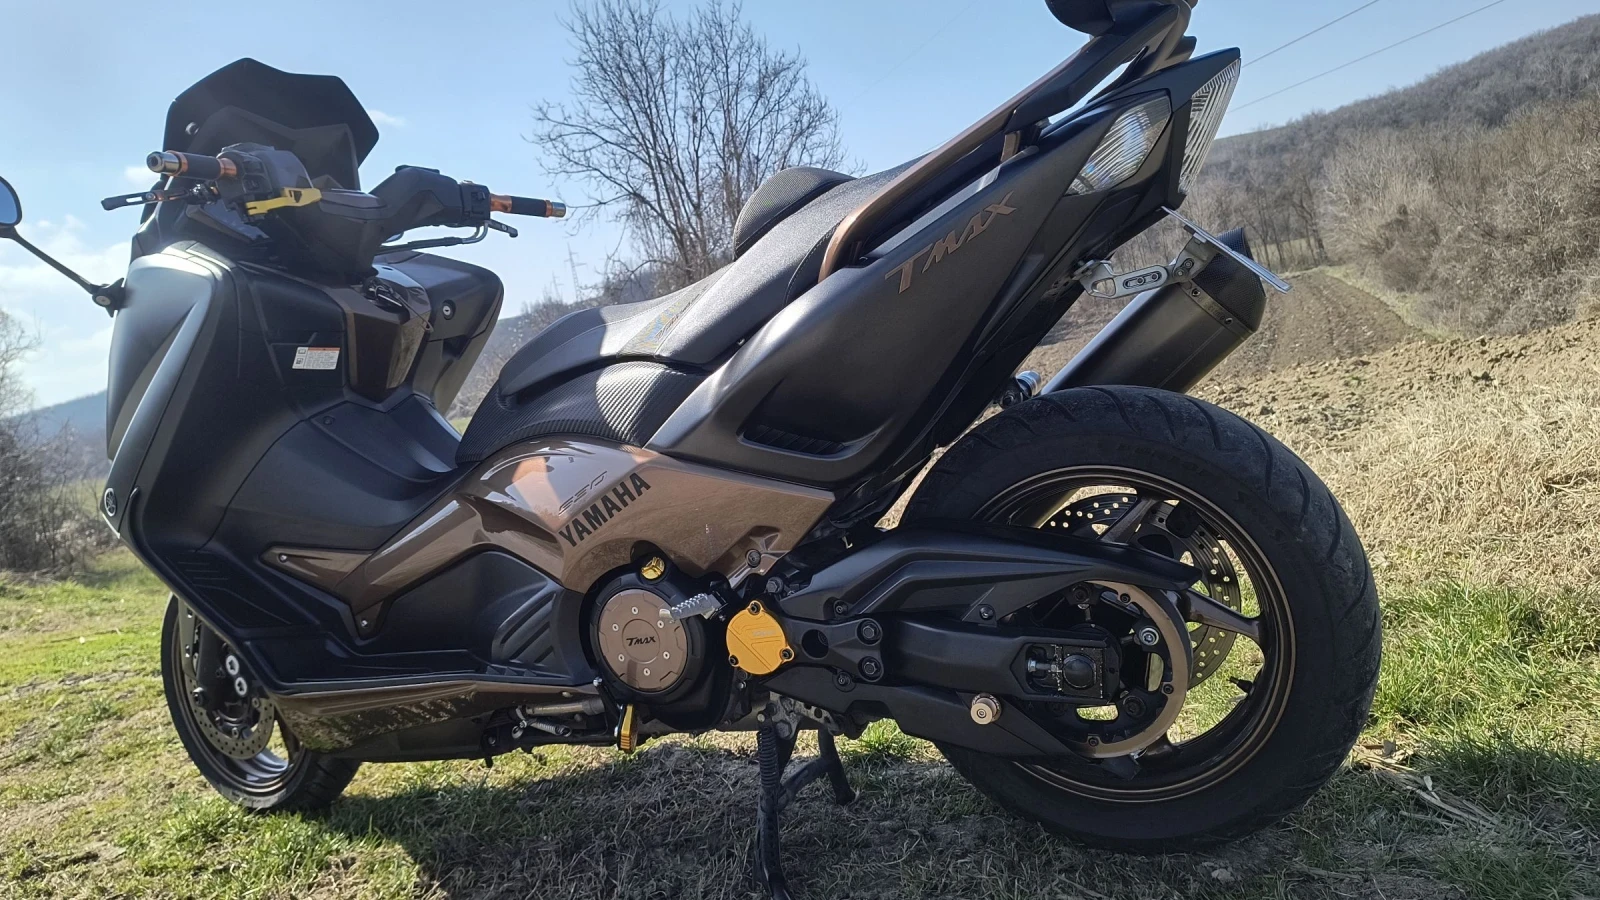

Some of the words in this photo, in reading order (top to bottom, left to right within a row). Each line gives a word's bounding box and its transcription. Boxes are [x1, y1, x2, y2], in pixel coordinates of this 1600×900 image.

[884, 189, 1018, 295] TMAX
[558, 472, 652, 547] YAMAHA
[626, 636, 657, 647] TMAX
